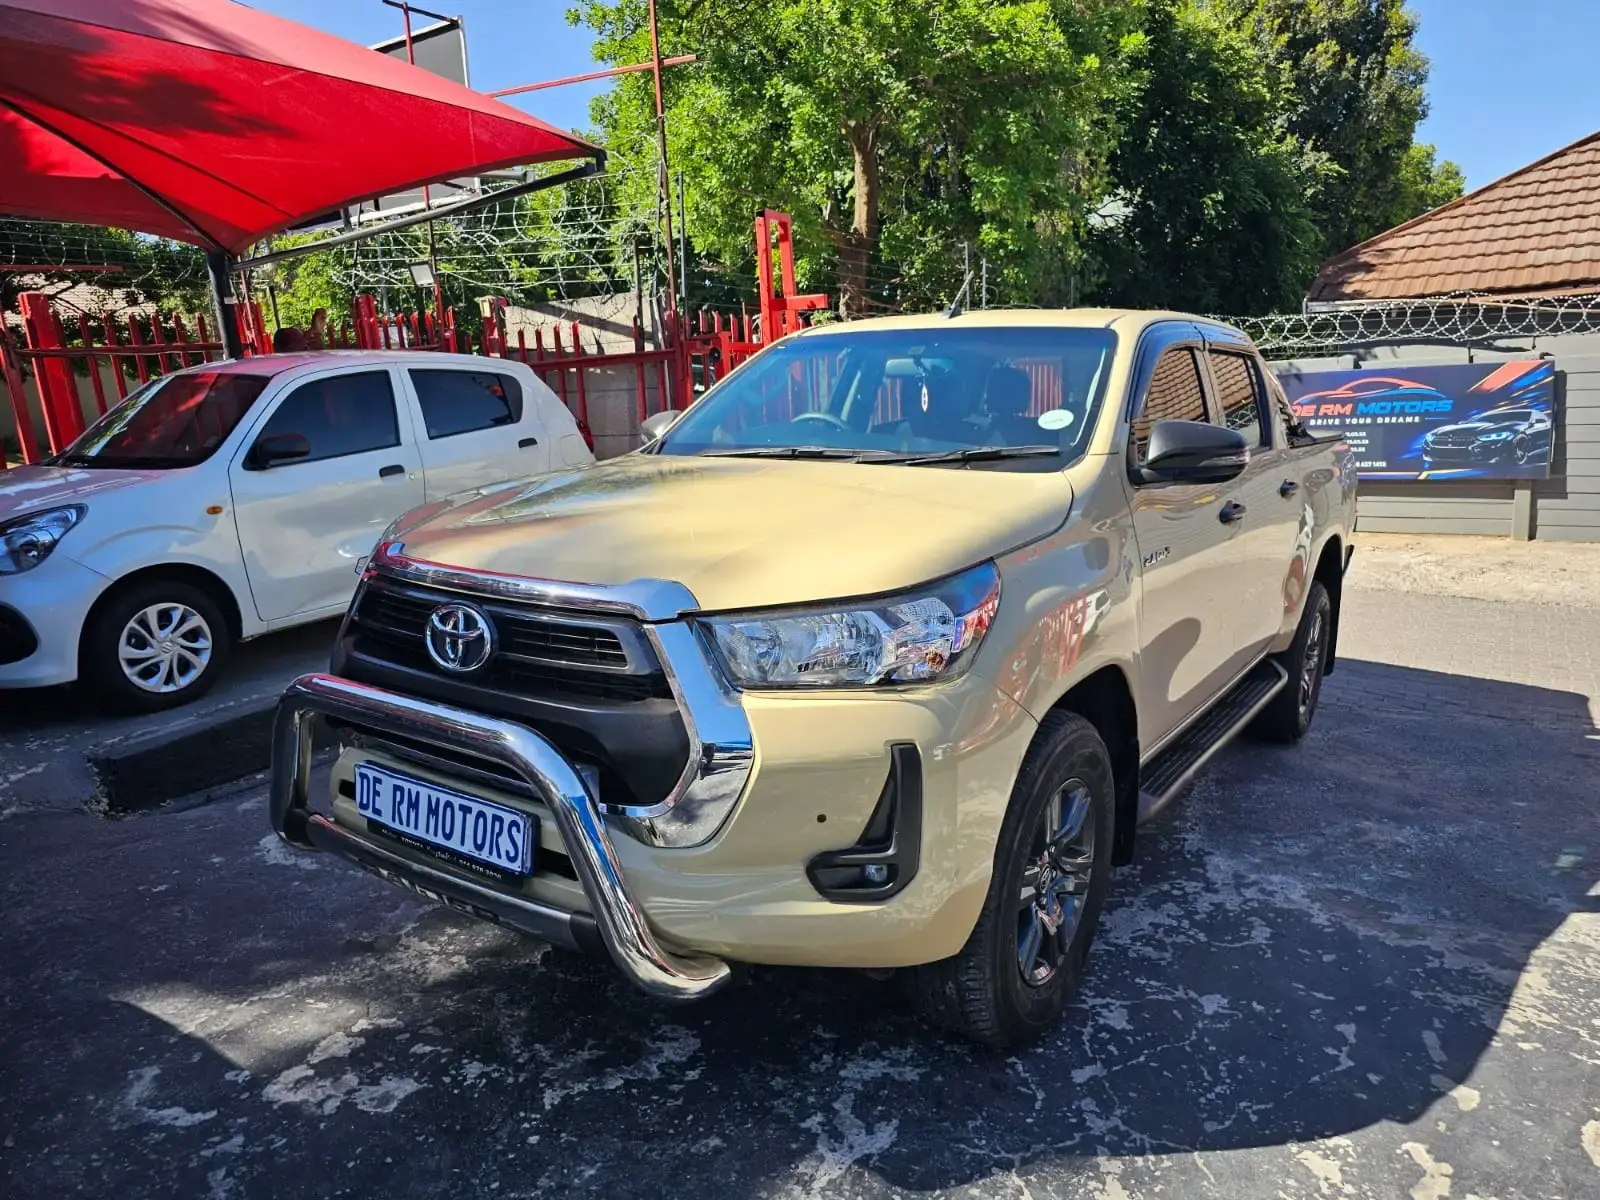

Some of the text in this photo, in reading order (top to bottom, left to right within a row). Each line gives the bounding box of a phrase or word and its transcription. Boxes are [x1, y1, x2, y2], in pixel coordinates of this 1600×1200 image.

[1318, 403, 1353, 416] RM
[1356, 400, 1453, 415] MOTORS
[1309, 416, 1420, 426] DRIVE YOUR DREAMS
[358, 772, 383, 817] DE
[391, 783, 421, 831] RM
[425, 794, 522, 864] MOTORS
